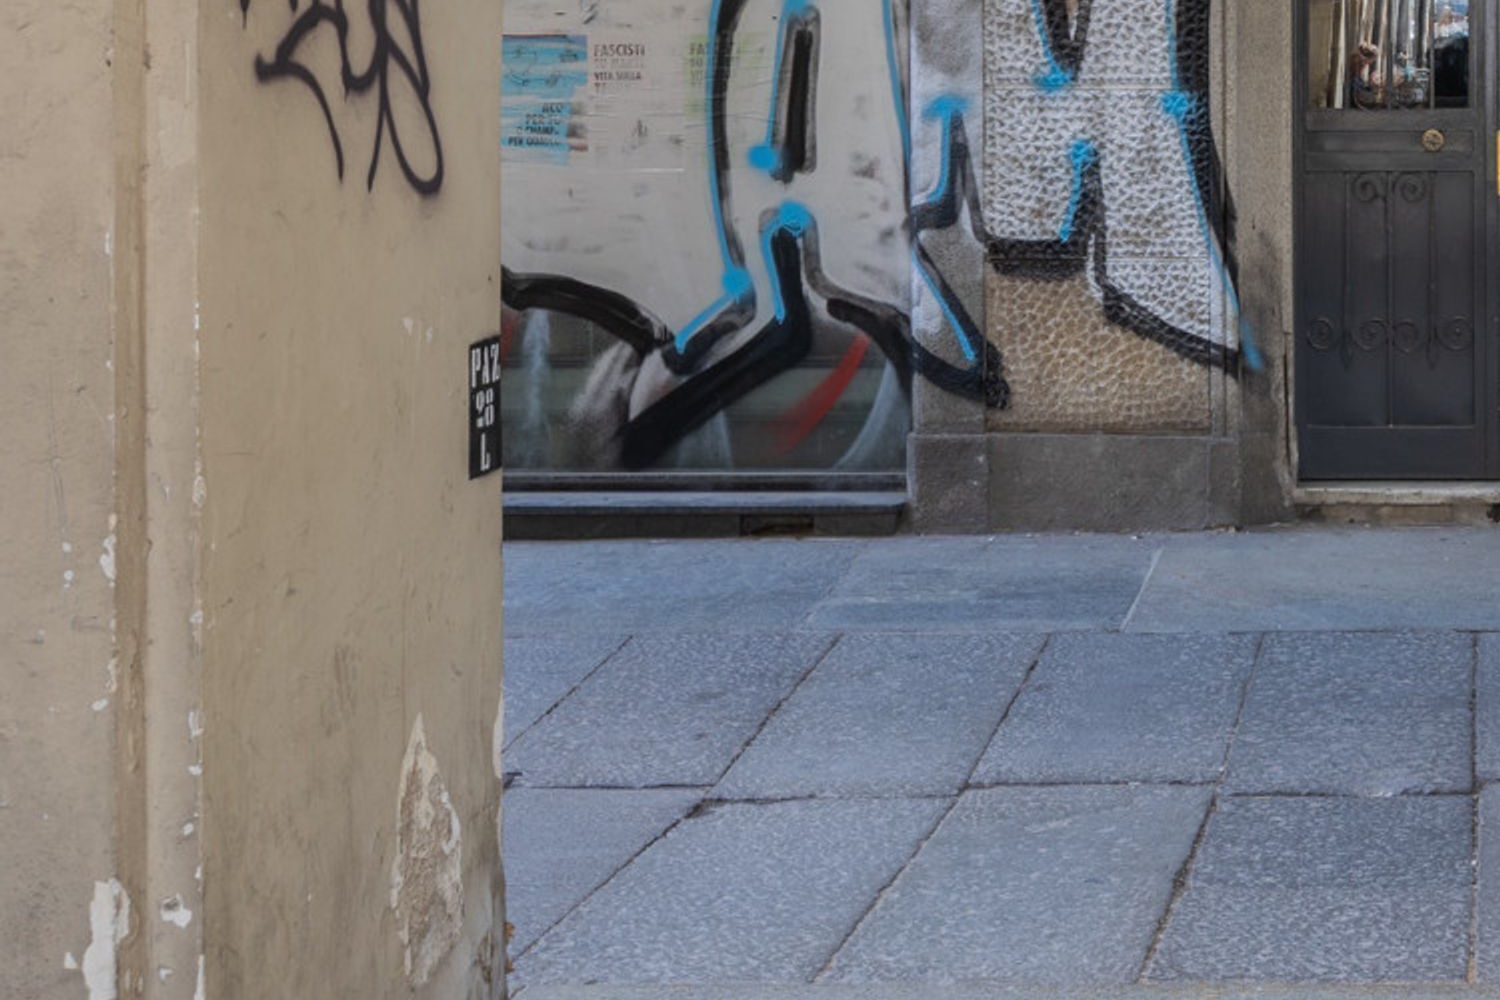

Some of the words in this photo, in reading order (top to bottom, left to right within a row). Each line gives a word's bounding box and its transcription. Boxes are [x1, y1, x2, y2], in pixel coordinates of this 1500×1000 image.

[593, 43, 646, 56] FASCISTI
[471, 344, 501, 388] PAZ
[480, 432, 491, 471] L
